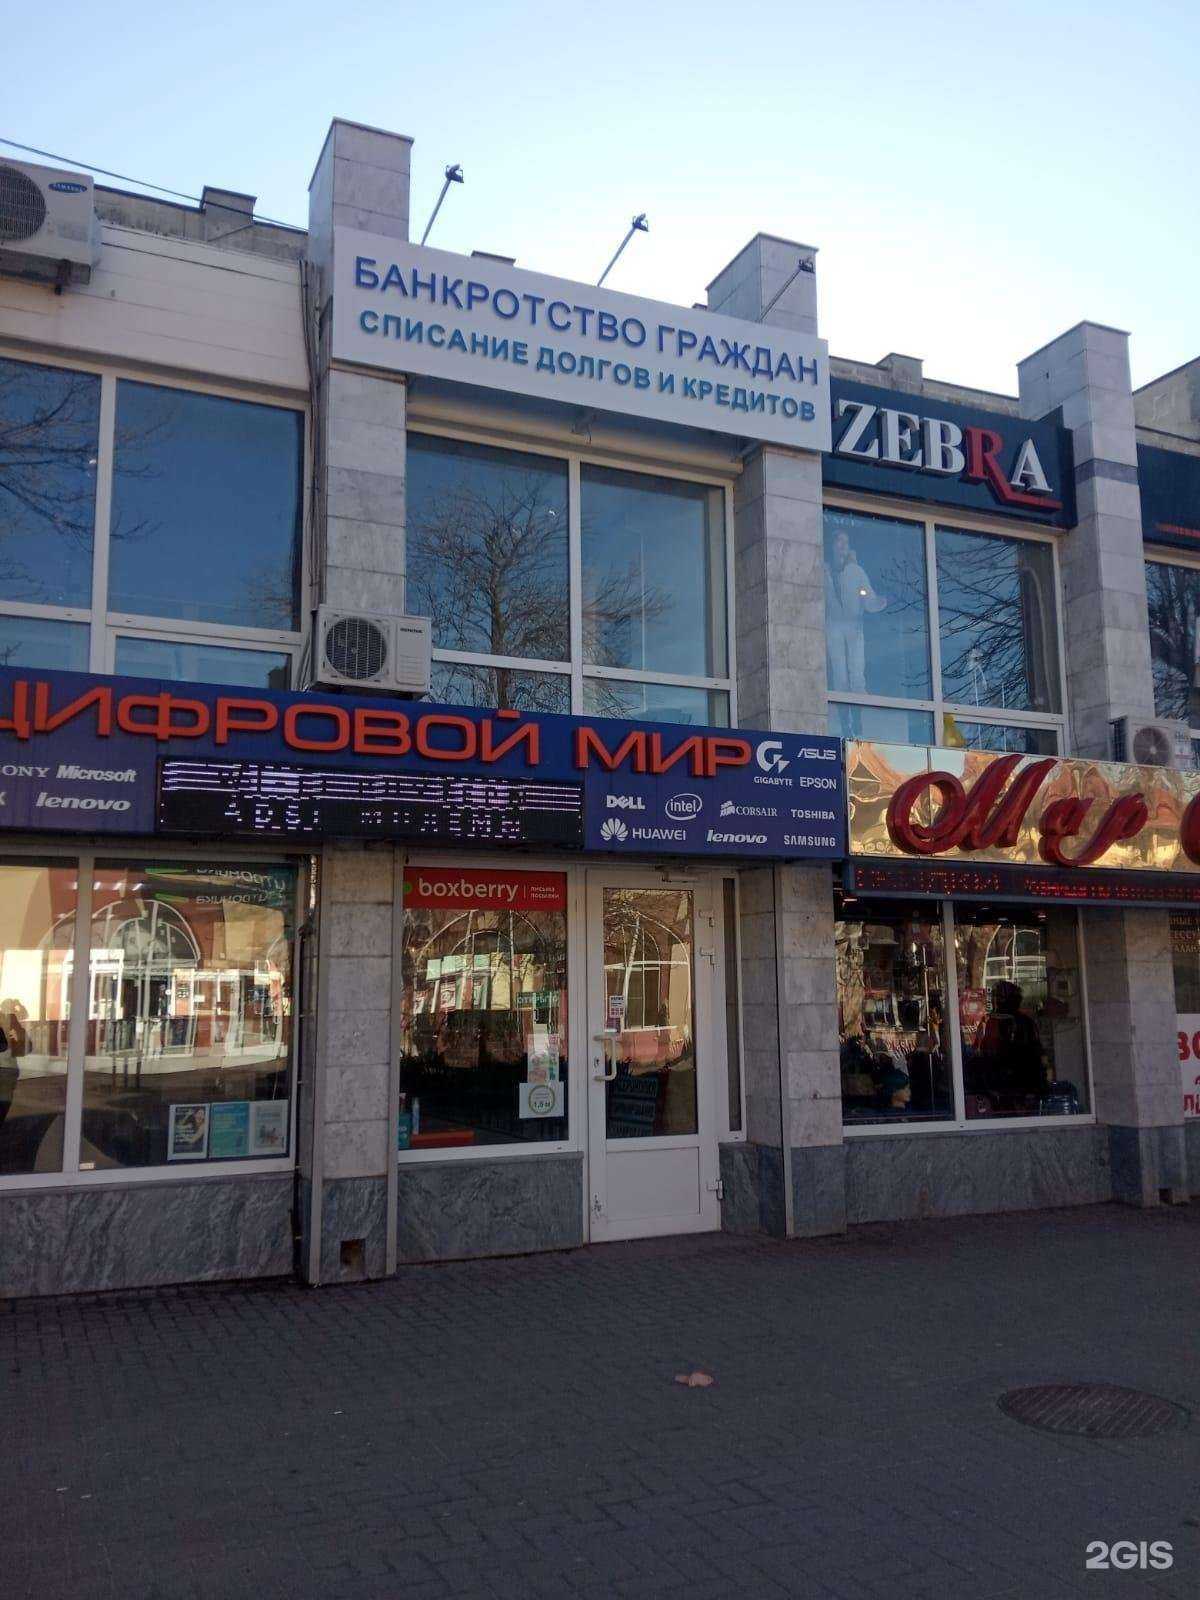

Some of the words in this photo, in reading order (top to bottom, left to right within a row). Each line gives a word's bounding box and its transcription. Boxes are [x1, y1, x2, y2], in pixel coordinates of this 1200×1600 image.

[355, 256, 647, 347] БАНКРОТСТВО
[657, 325, 818, 385] ГРАЖДАН
[360, 310, 529, 364] СПИСАНИЕ
[536, 347, 651, 389] ДОЛГОВ
[658, 371, 675, 394] И
[682, 376, 816, 421] КРЕДИТОВ
[837, 399, 1062, 510] ZEBRA
[575, 726, 751, 777] МИР
[797, 747, 837, 761] ASUS
[0, 764, 50, 778] ONY
[56, 764, 137, 783] Microsoft
[754, 776, 793, 786] GIGABYTE
[800, 776, 837, 790] EPSON
[36, 791, 131, 811] lenovo
[606, 794, 646, 810] DELL
[669, 802, 697, 814] intel
[735, 806, 778, 818] CORSAIR
[791, 808, 836, 821] TOSHIBA
[632, 828, 687, 841] HUAWEI
[706, 829, 768, 844] lenovo
[783, 834, 836, 847] SAMSUNG
[418, 877, 519, 902] boxberry
